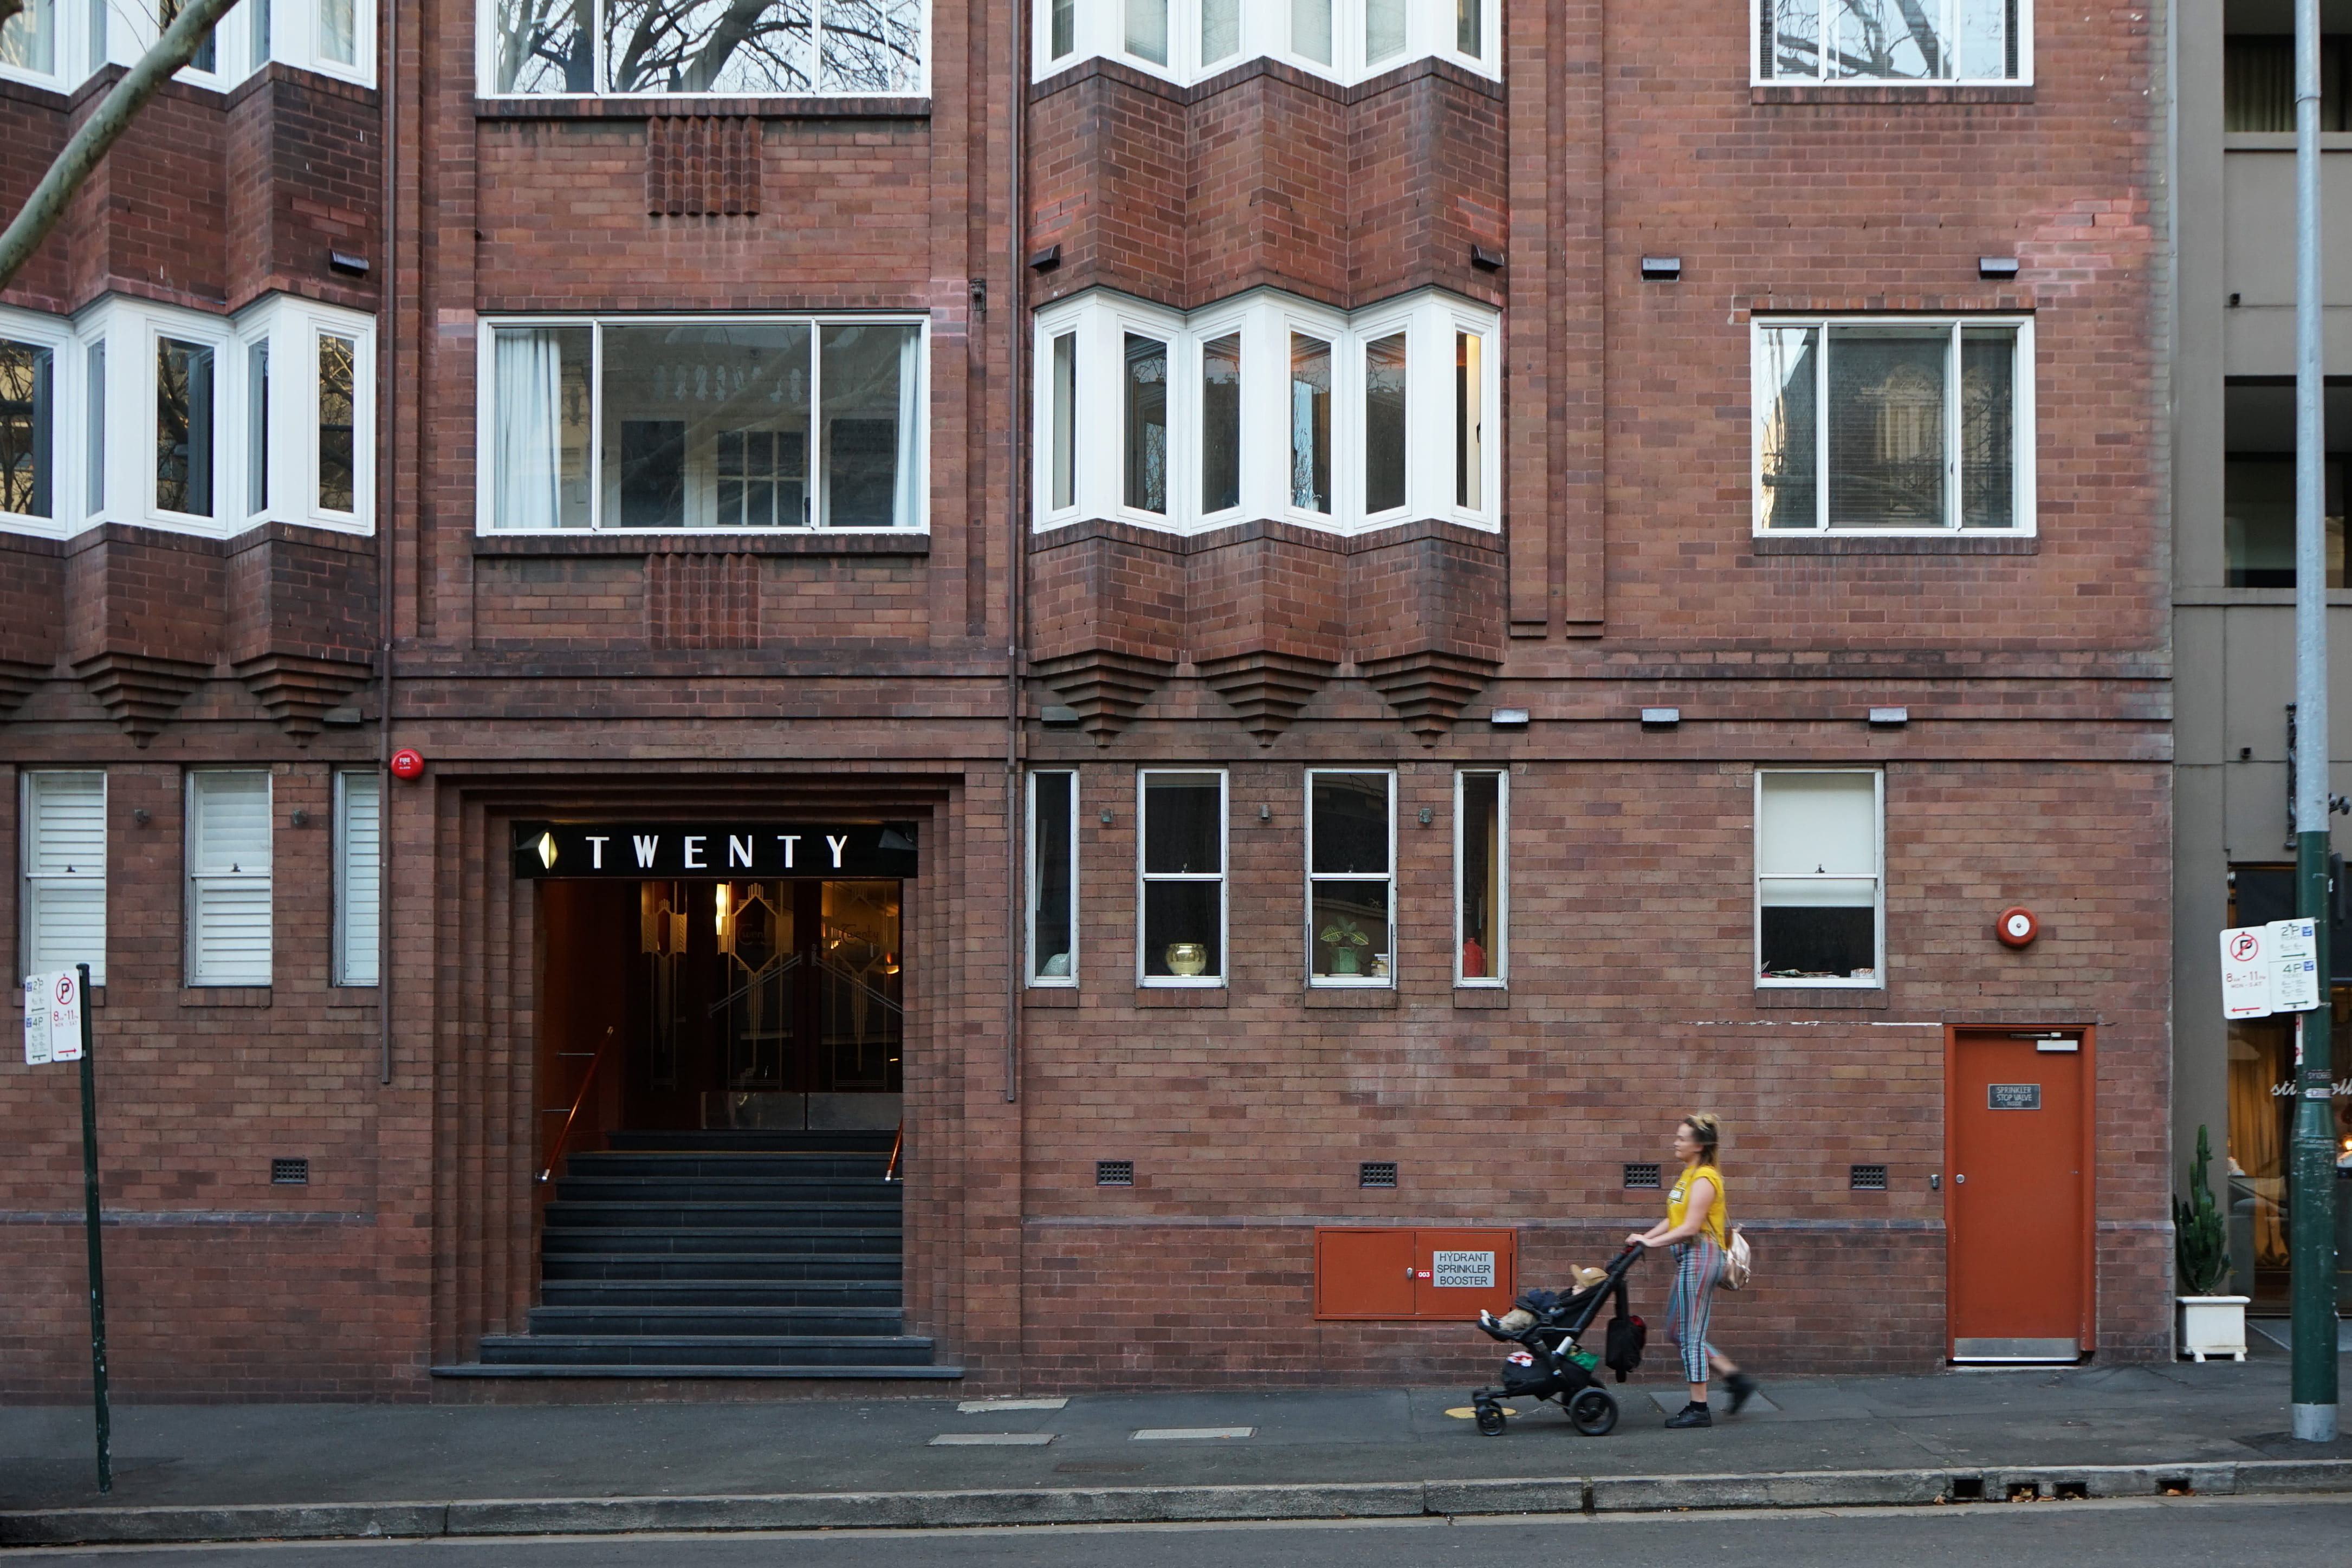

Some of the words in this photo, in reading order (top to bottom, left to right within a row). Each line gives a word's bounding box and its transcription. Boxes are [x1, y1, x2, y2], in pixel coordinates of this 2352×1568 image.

[586, 835, 847, 869] TWENTY
[2280, 925, 2300, 936] 2P
[2283, 963, 2303, 973] 4P
[33, 1017, 43, 1026] 4P
[1439, 1253, 1488, 1262] HYDRANT
[1436, 1265, 1491, 1273] SPRINKLER
[1440, 1276, 1488, 1285] BOOSTER
